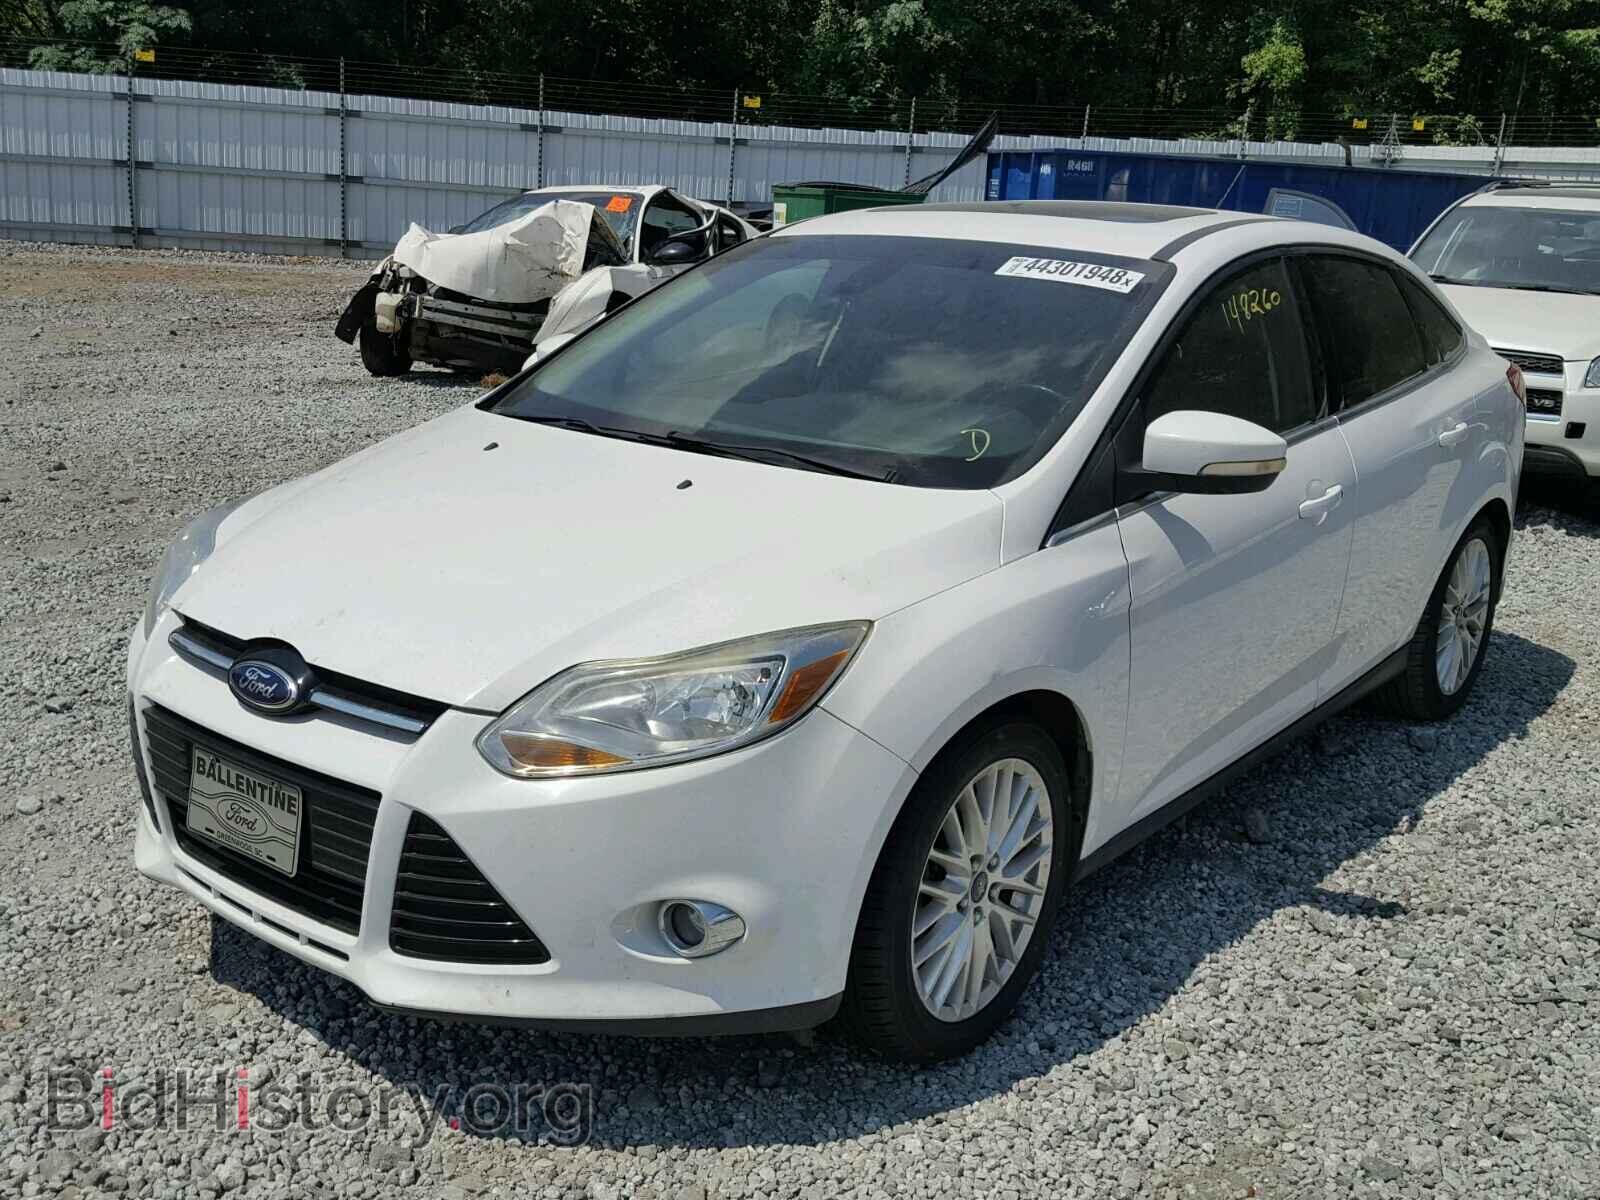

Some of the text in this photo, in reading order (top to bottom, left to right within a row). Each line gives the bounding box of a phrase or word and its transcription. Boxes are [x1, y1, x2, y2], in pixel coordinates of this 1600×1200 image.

[960, 428, 990, 461] D
[239, 667, 278, 698] Ford
[196, 756, 297, 816] BALLENTINE
[225, 802, 258, 832] Ford
